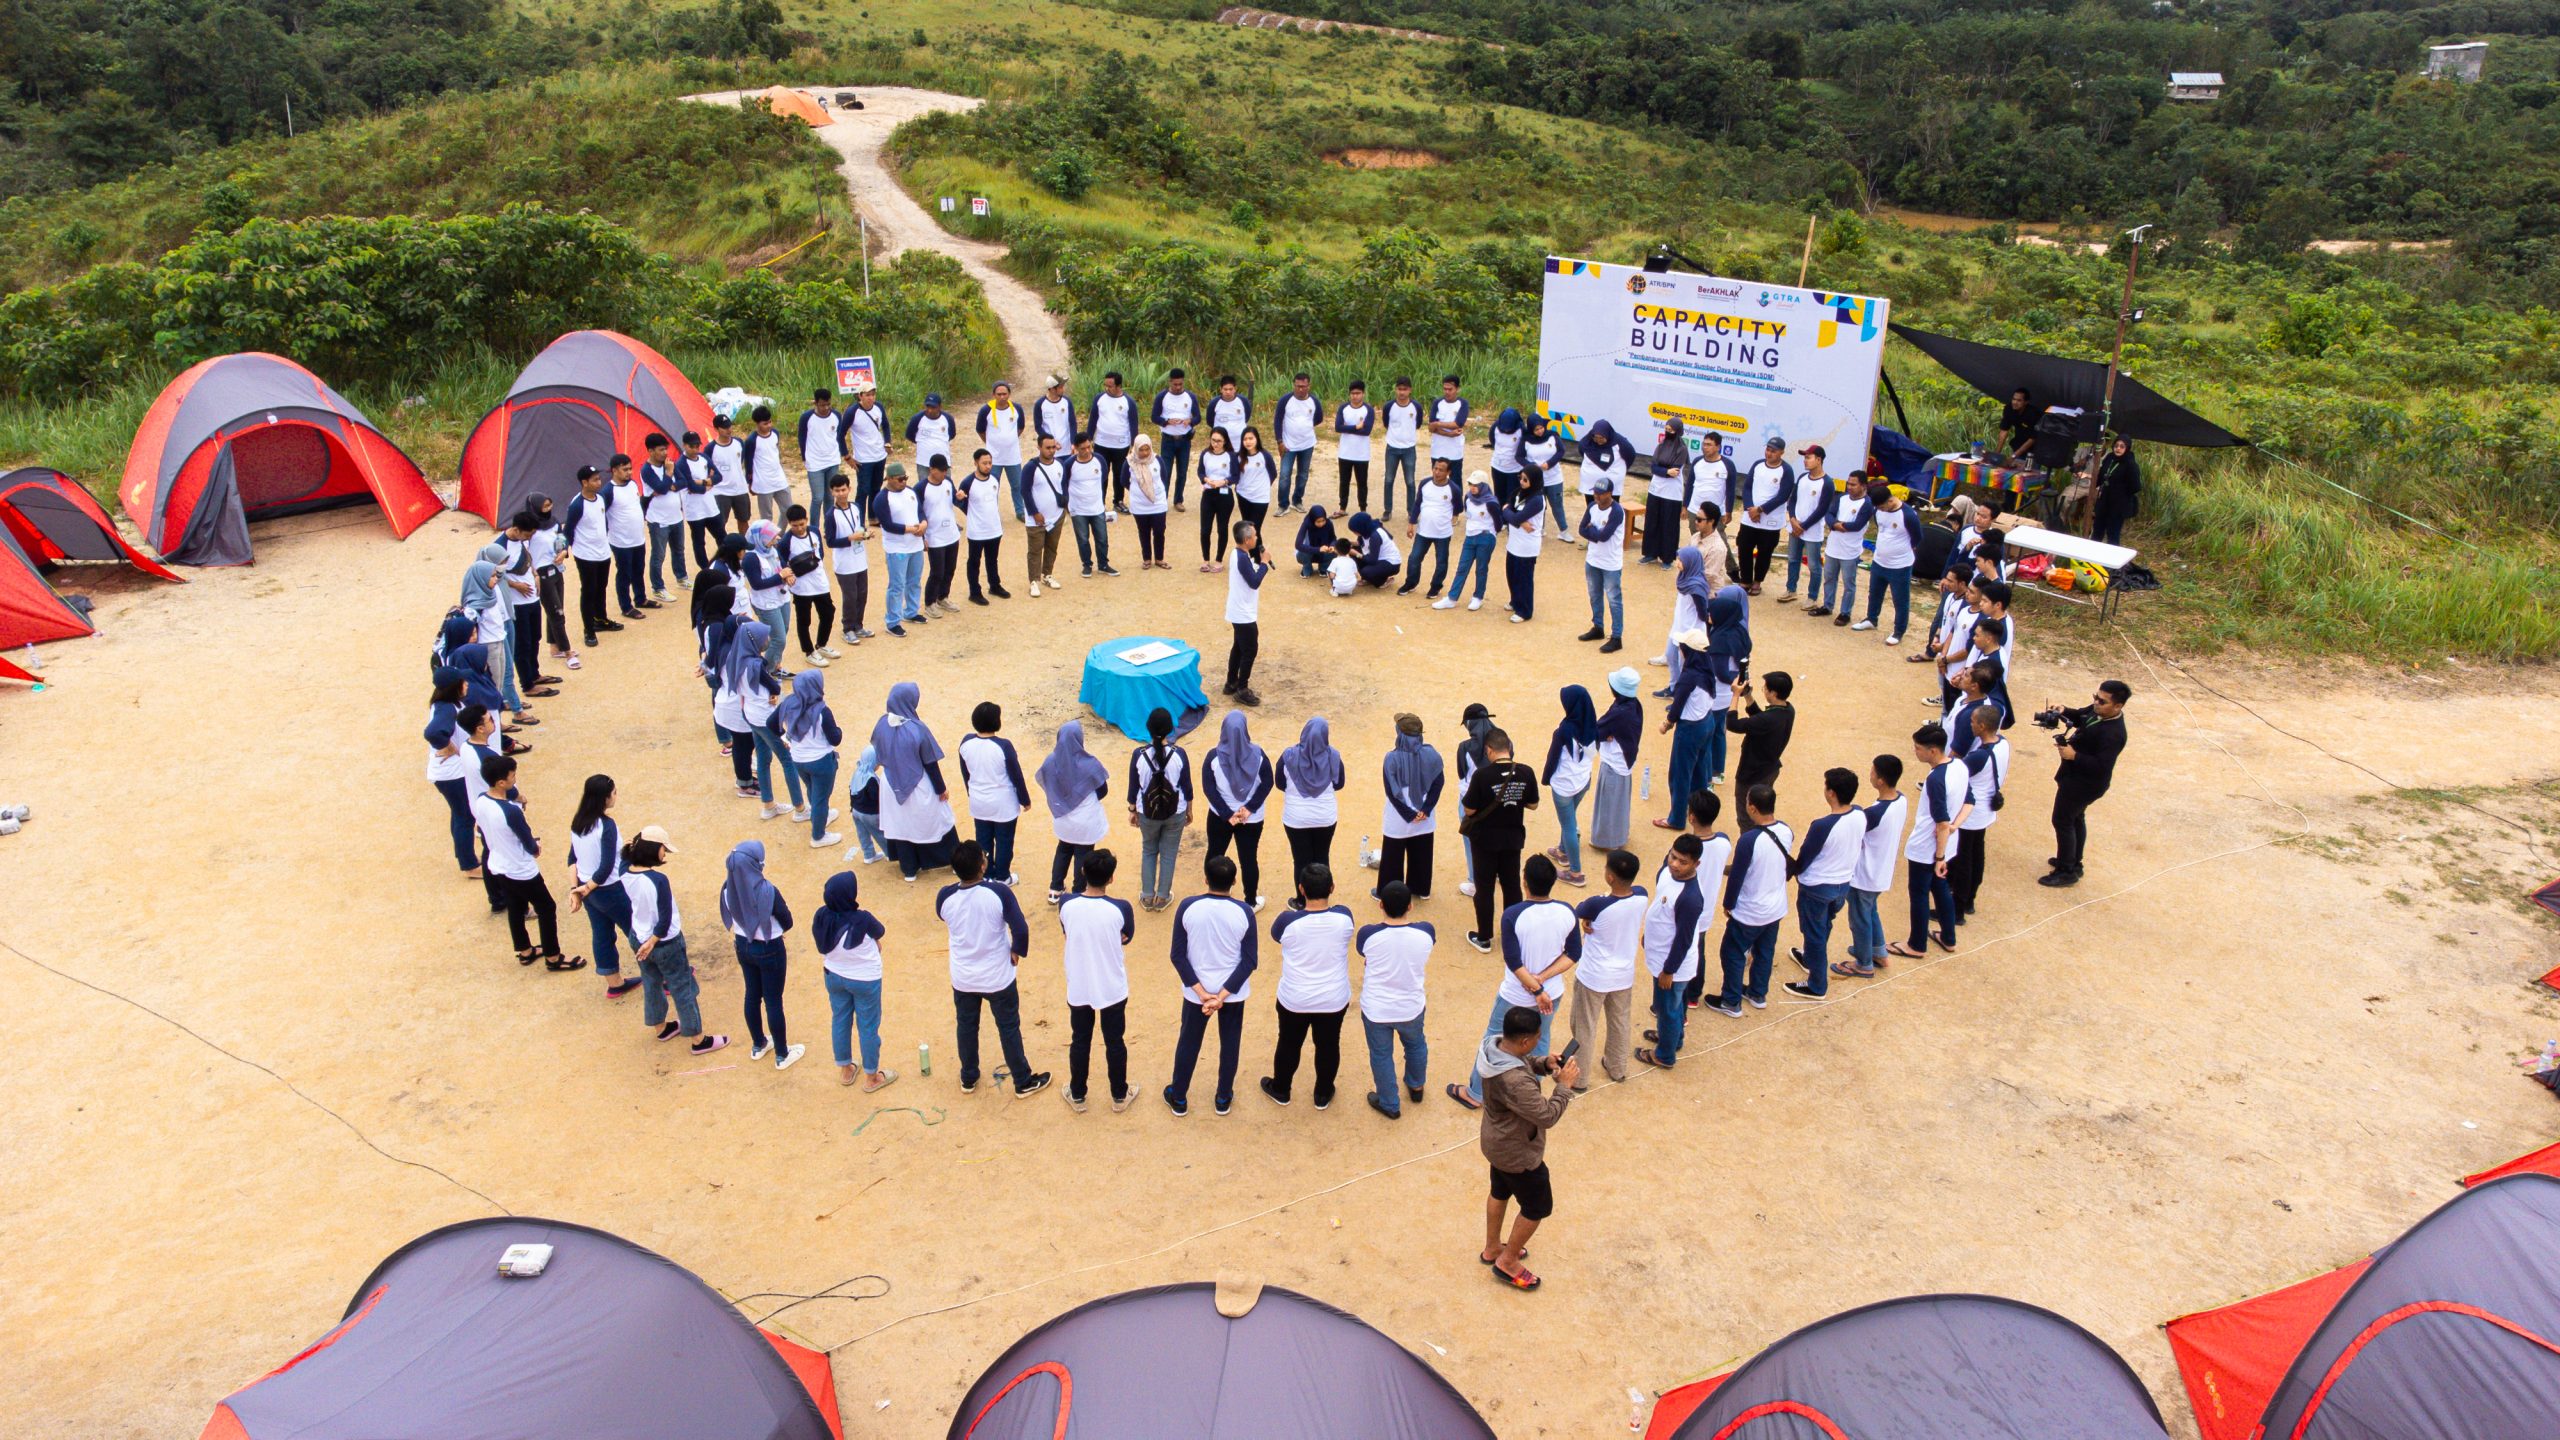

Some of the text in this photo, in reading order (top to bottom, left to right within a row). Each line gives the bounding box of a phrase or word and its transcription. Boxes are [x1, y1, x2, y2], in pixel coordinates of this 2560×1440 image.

[1697, 285, 1739, 298] BerAKHLAK
[1773, 293, 1801, 303] GTRA
[1633, 304, 1786, 343] CAPACITY
[1631, 328, 1779, 368] BUILDING
[1614, 358, 1631, 367] Dalam
[1681, 369, 1696, 378] Zona
[1723, 376, 1735, 385] dan
[1736, 378, 1766, 389] Reformasi
[1669, 358, 1693, 368] Karakter
[1694, 362, 1716, 372] Sumber
[1716, 365, 1731, 374] Daya
[1732, 368, 1756, 378] Manusia
[1730, 420, 1745, 430] 2023
